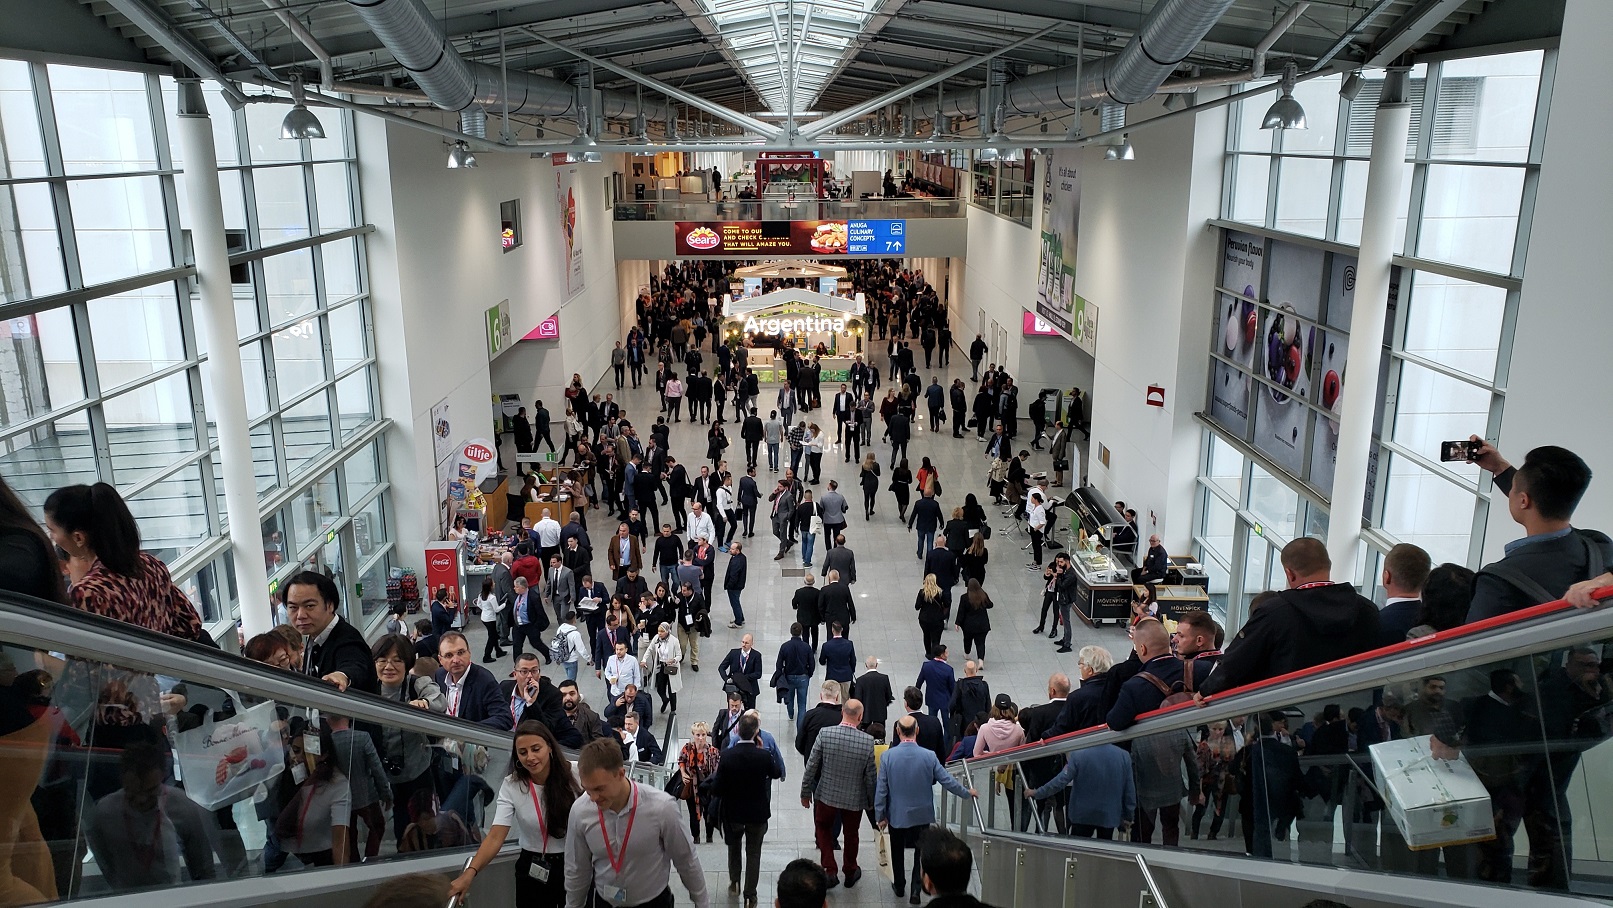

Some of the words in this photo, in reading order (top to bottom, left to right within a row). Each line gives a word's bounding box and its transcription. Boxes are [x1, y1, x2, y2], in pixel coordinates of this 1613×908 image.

[688, 236, 717, 245] Seara
[886, 242, 892, 251] 7
[744, 314, 845, 335] Argentina
[1040, 320, 1046, 330] 9
[1078, 310, 1083, 342] 9
[494, 318, 500, 351] 6
[467, 446, 490, 460] ültje
